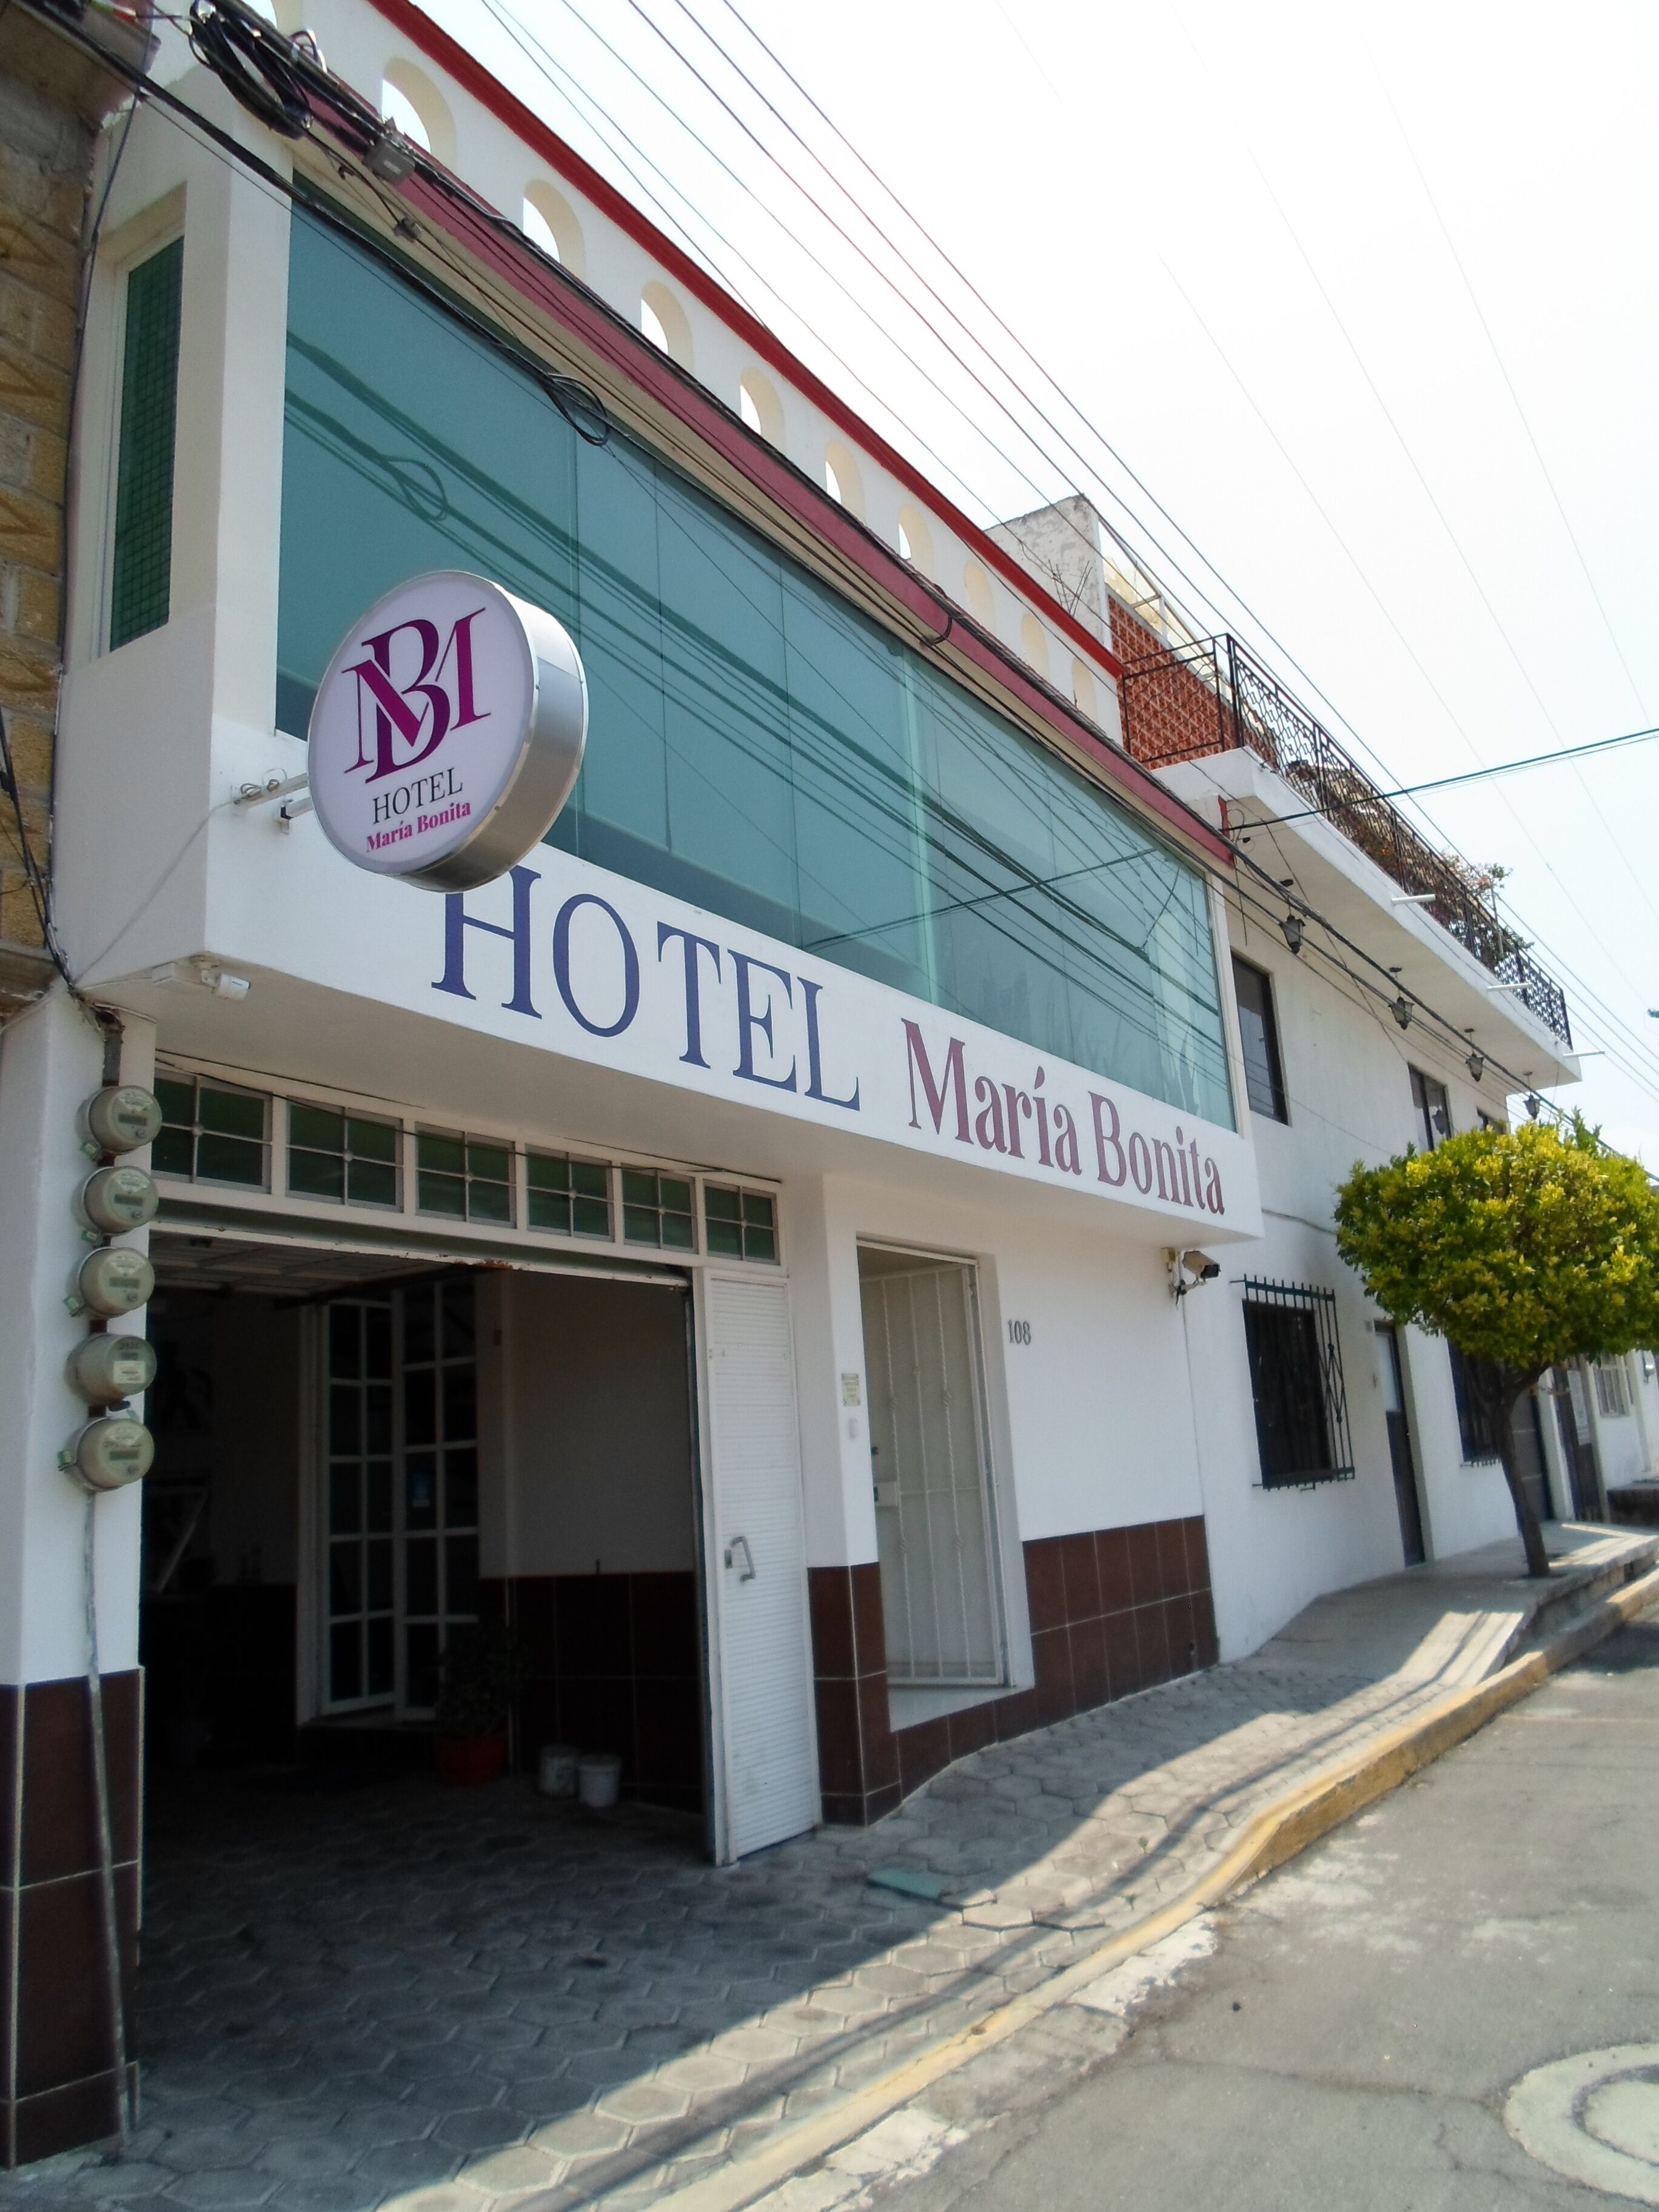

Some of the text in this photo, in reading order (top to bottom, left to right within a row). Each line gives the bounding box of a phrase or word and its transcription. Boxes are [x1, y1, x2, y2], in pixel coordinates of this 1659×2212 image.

[372, 767, 463, 825] HOTEL
[366, 802, 471, 853] María Bonita
[431, 865, 1225, 1215] HOTEL María Bonita
[1008, 1319, 1031, 1346] 108
